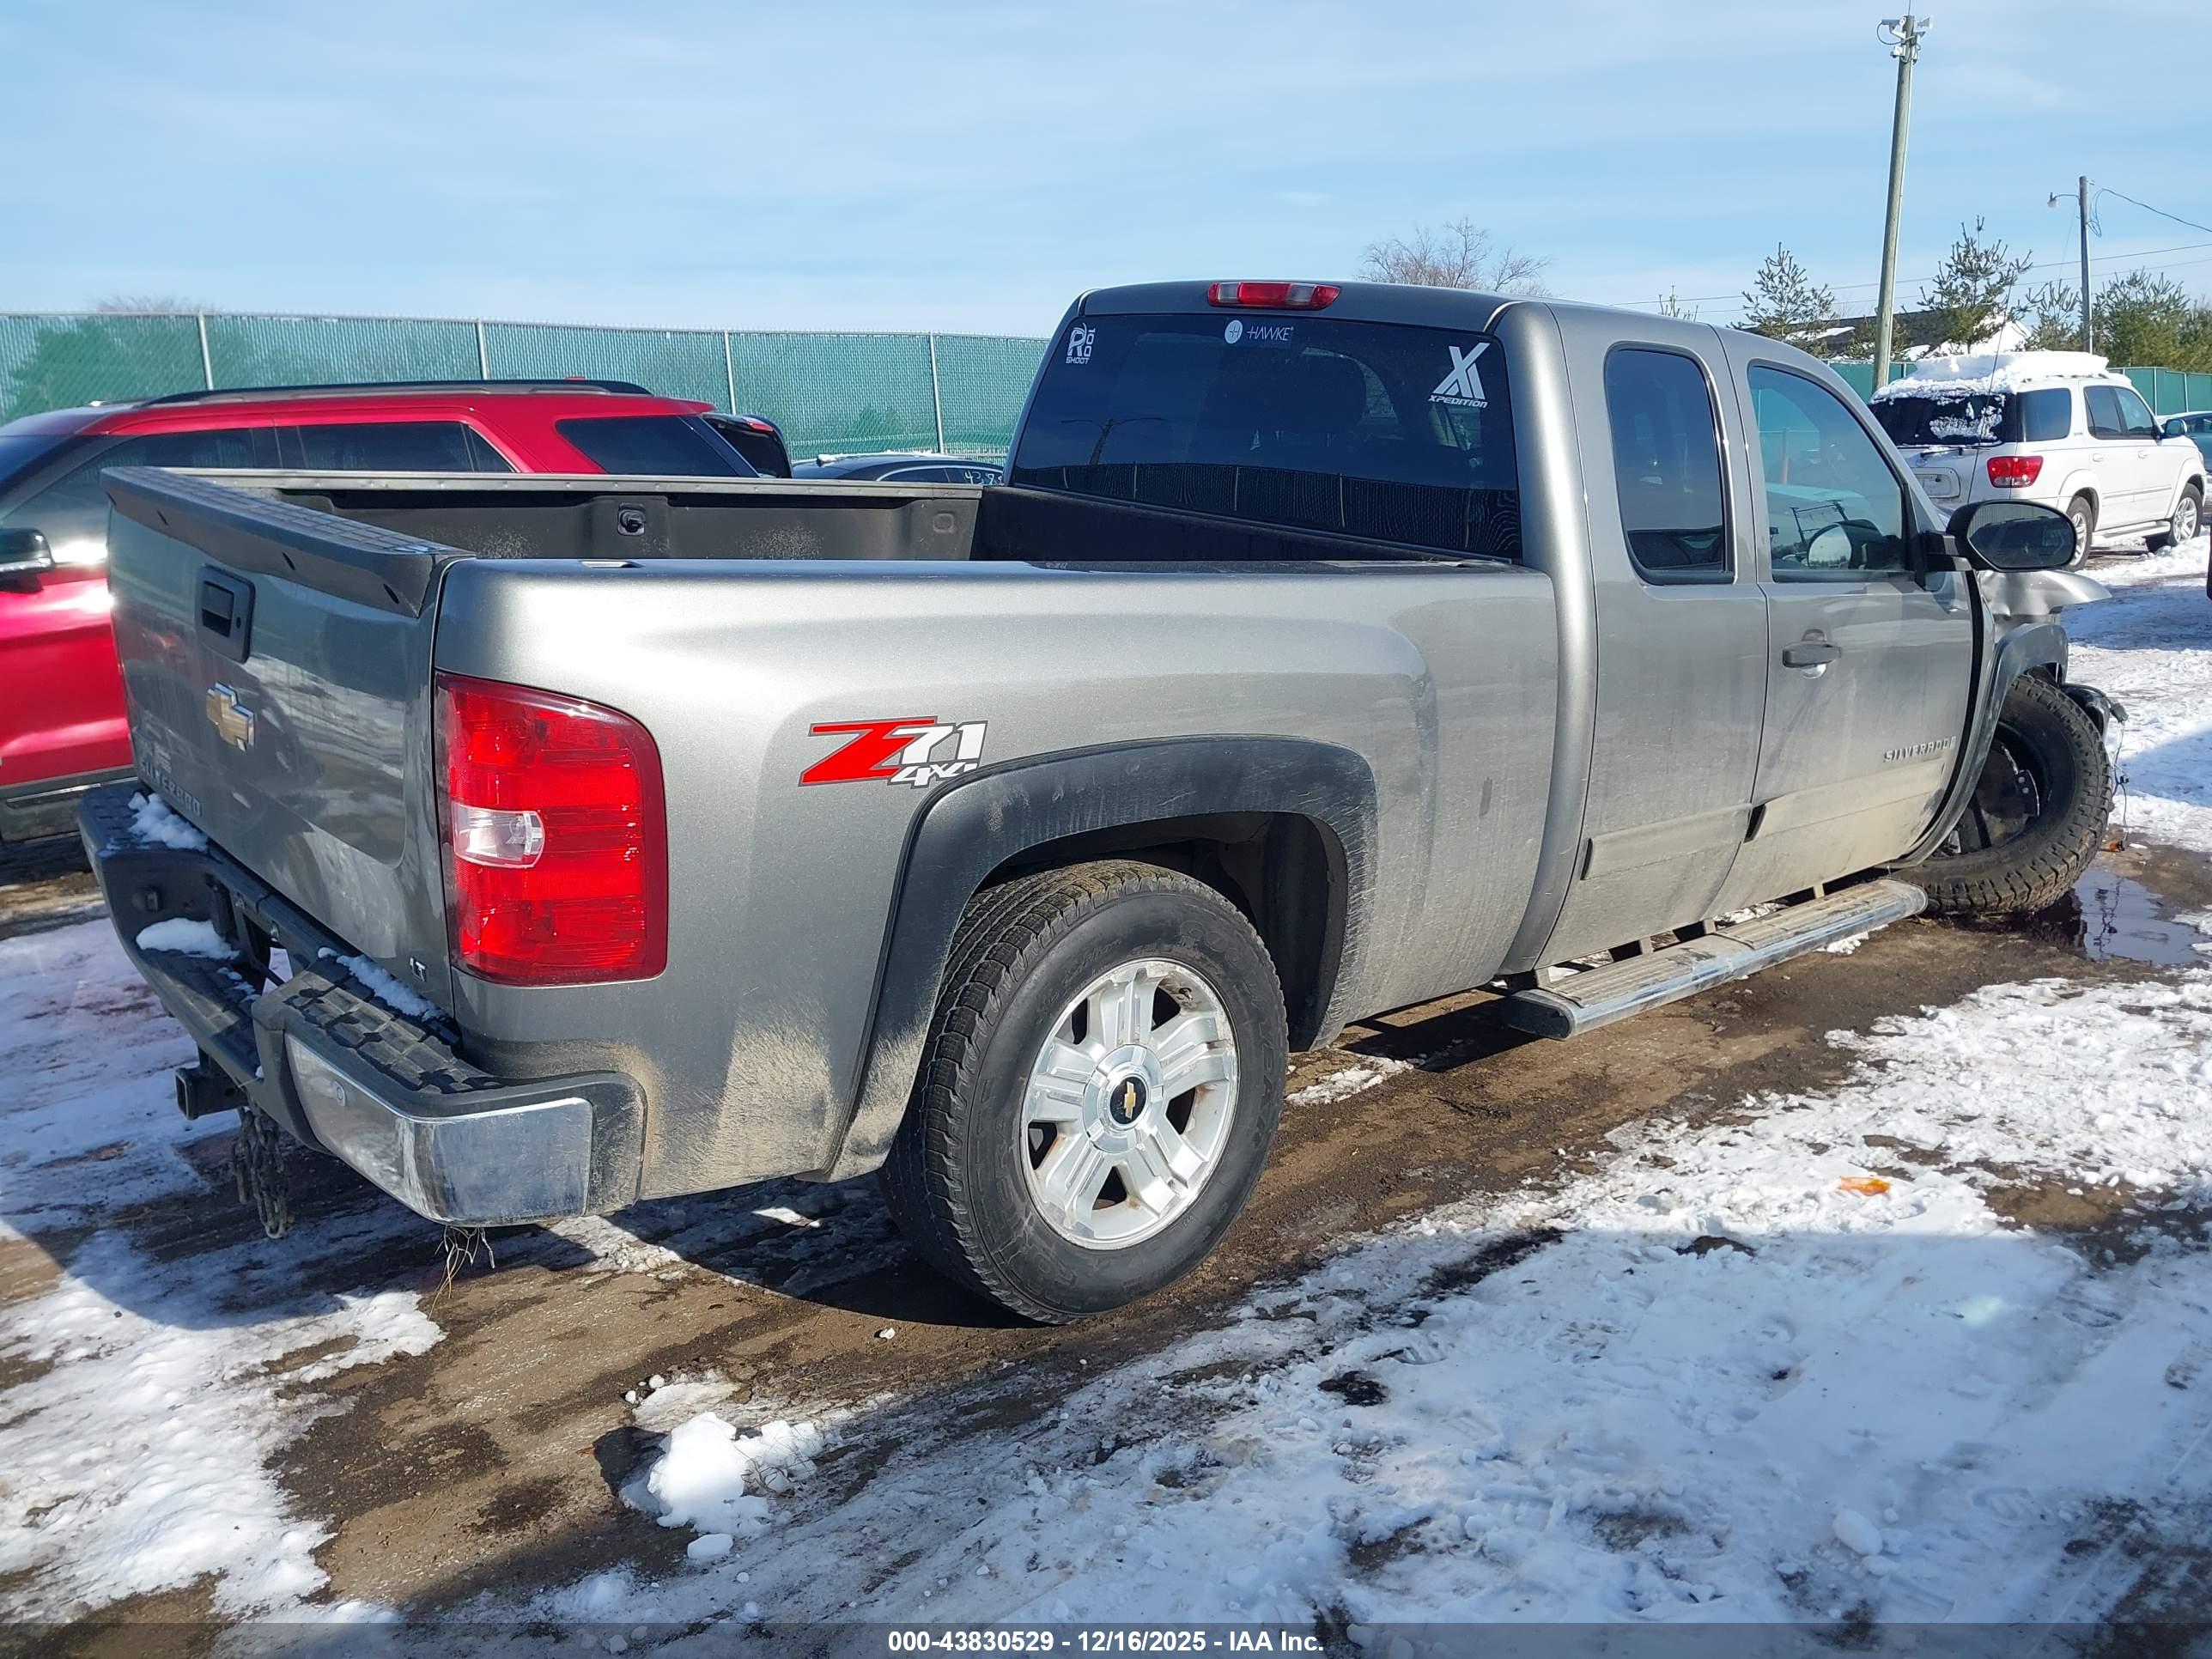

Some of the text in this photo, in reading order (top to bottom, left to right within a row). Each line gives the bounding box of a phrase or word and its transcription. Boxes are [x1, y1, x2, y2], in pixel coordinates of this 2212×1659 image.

[799, 715, 988, 787] Z71
[1883, 735, 1957, 763] SILVERADO
[410, 957, 426, 982] LT
